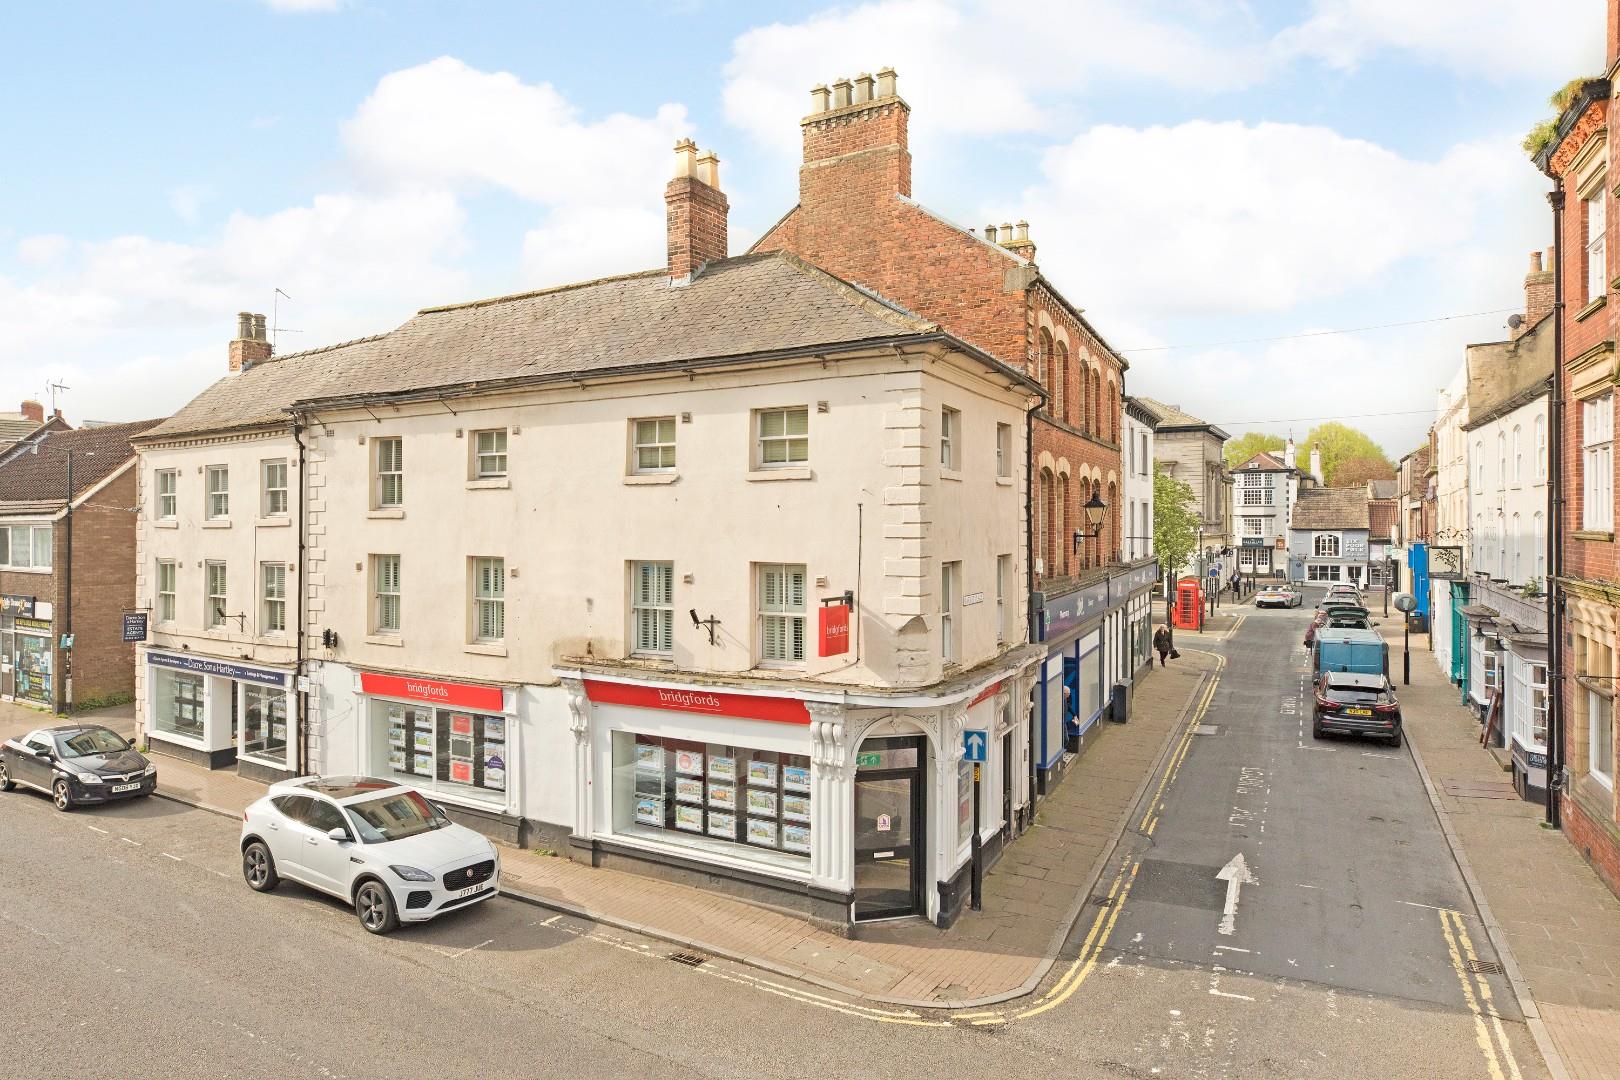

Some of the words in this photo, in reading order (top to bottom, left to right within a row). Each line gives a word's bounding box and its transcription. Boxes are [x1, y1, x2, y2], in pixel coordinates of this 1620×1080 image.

[203, 661, 213, 671] Son
[216, 663, 236, 676] Hartley
[407, 681, 449, 697] bridgfords
[658, 689, 720, 707] bridgfords
